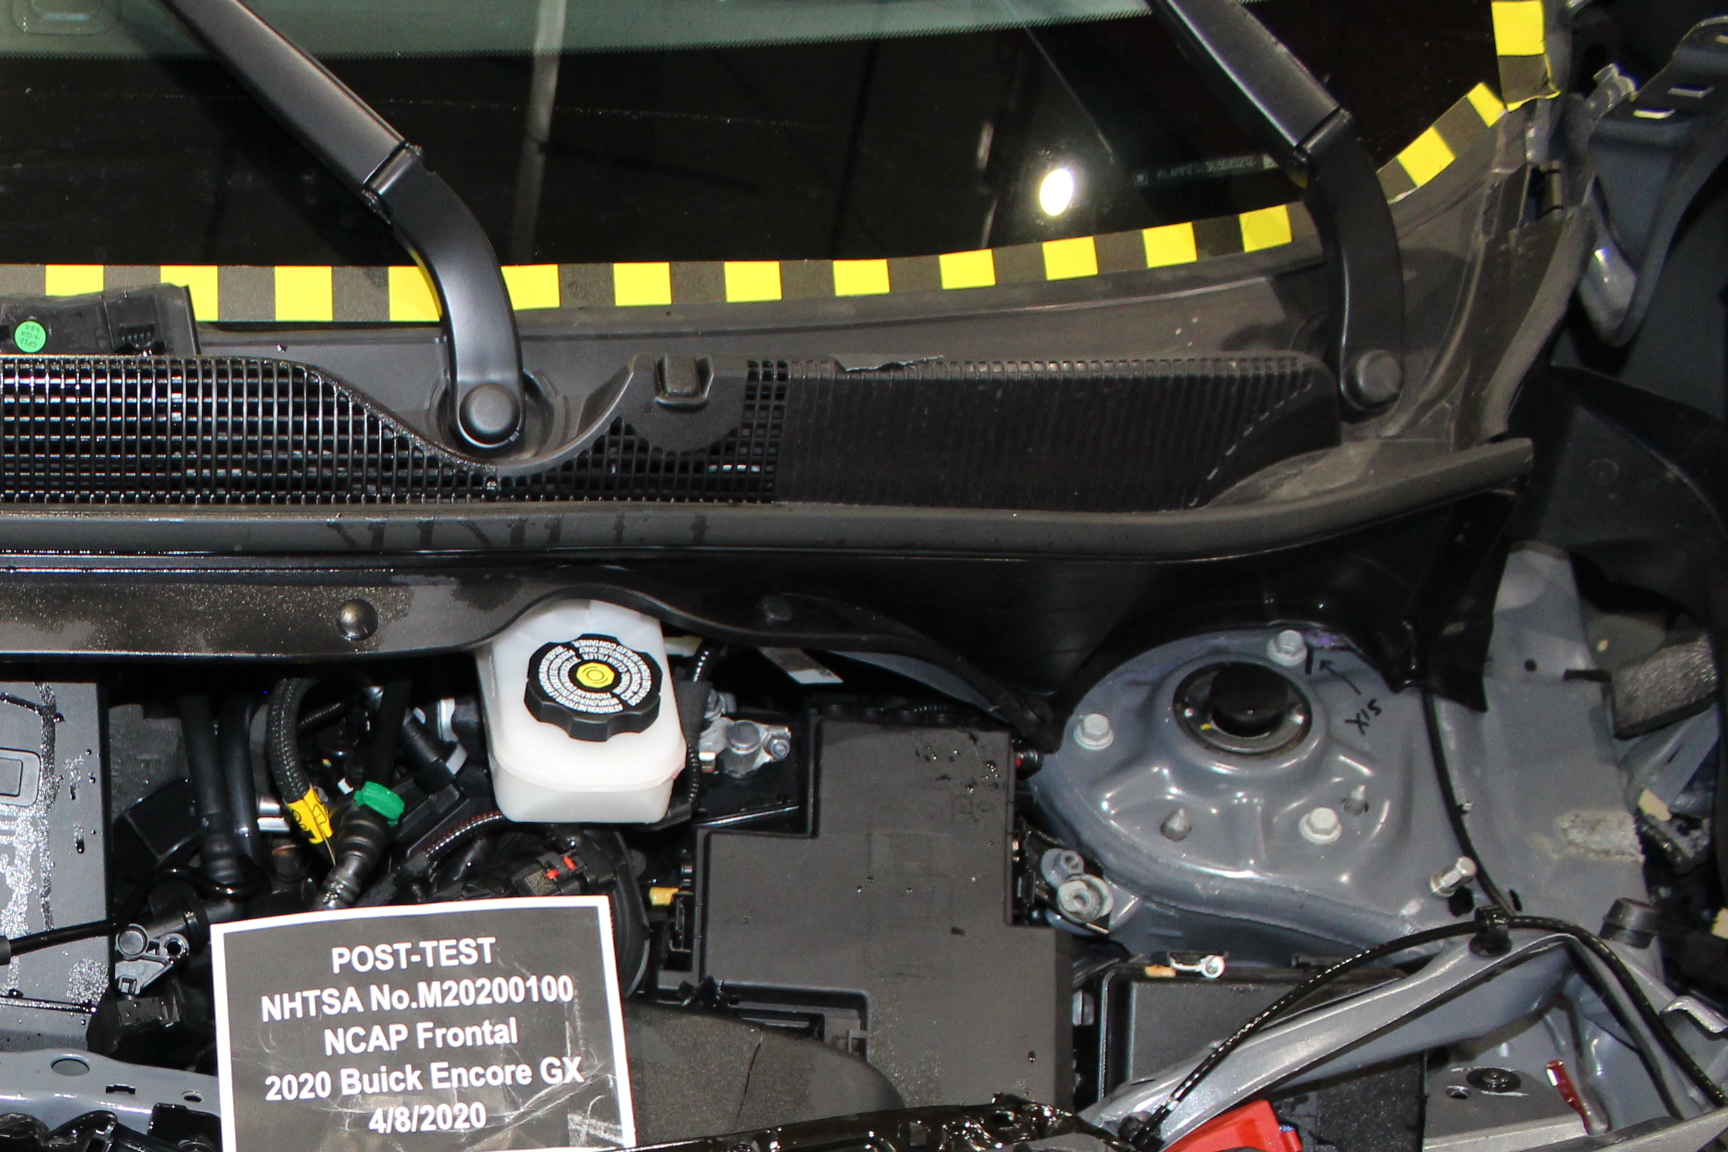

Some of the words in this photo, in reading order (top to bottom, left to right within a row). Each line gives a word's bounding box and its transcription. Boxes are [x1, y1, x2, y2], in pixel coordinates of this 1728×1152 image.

[331, 936, 497, 974] POST-TEST
[261, 987, 364, 1022] NHTSA
[370, 974, 574, 1012] No.M20200100
[323, 1023, 409, 1056] NCAP
[417, 1017, 518, 1049] Frontal
[265, 1071, 332, 1102] 2020
[340, 1064, 423, 1097] Buick
[430, 1060, 533, 1090] Encore
[540, 1055, 585, 1084] GX
[368, 1101, 487, 1135] 4/8/2020
